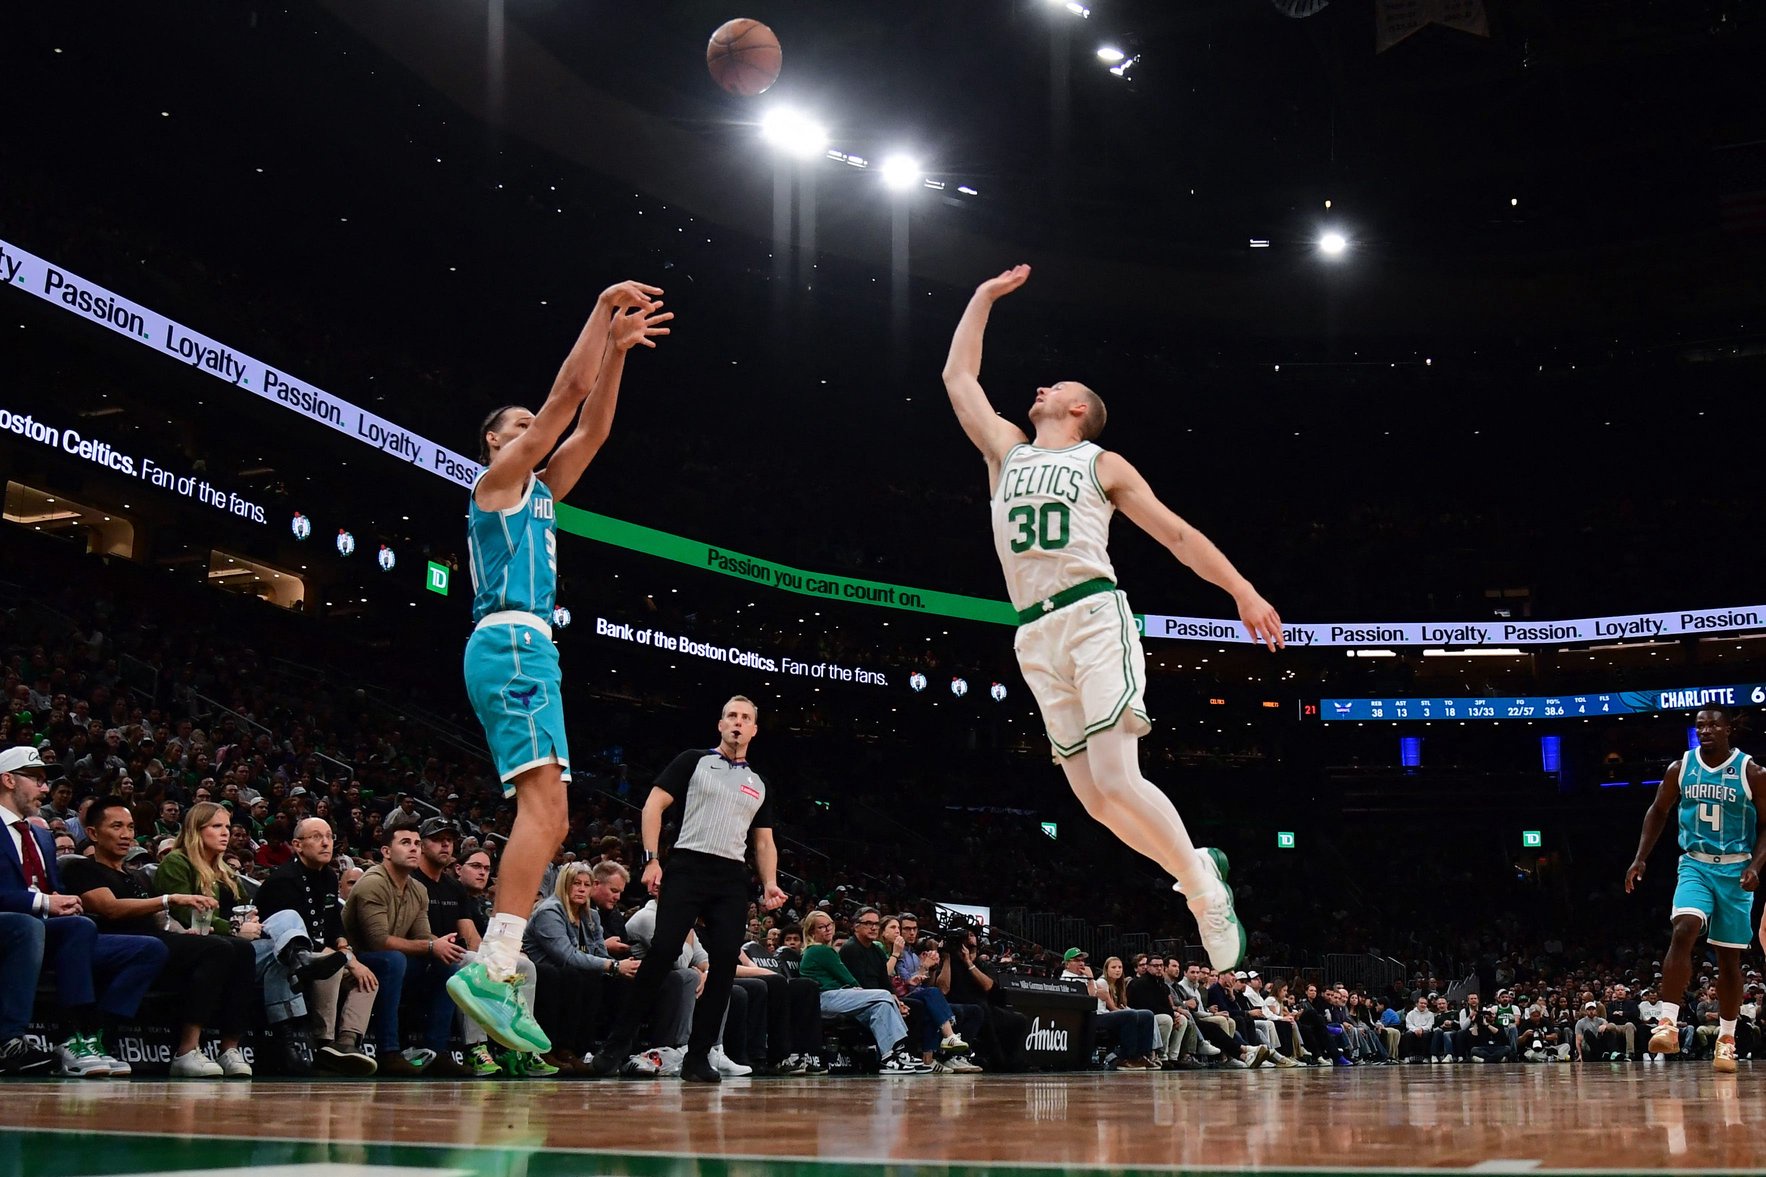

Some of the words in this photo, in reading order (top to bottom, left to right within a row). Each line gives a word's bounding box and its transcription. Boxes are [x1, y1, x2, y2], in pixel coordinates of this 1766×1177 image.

[44, 267, 149, 340] Passion.
[165, 324, 249, 386] Loyalty.
[263, 369, 345, 427] Passion.
[357, 413, 424, 464] Loyalty.
[434, 449, 478, 485] Passi
[62, 429, 138, 477] Celtics.
[141, 458, 175, 490] Fan
[178, 477, 196, 497] of
[199, 481, 226, 509] the
[229, 492, 268, 525] fans.
[1004, 464, 1083, 504] CELTICS
[1008, 502, 1071, 554] 30
[430, 567, 447, 589] TD
[707, 548, 771, 582] Passion
[774, 569, 803, 589] you
[805, 578, 840, 596] can
[843, 583, 896, 604] count
[899, 592, 926, 609] on.
[1165, 618, 1240, 639] Passion.
[1330, 626, 1410, 642] Passion.
[1421, 625, 1492, 644] Loyalty.
[1503, 624, 1583, 641] Passion.
[1594, 616, 1668, 638] Loyalty.
[1680, 610, 1764, 631] Passion.
[596, 617, 634, 642] Bank
[636, 629, 653, 646] of
[654, 631, 677, 650] the
[679, 636, 727, 662] Boston
[728, 648, 779, 673] Celtics.
[781, 658, 809, 676] Fan
[811, 662, 827, 678] of
[828, 664, 852, 681] the
[854, 667, 889, 686] fans.
[1304, 704, 1317, 715] 21
[1371, 708, 1384, 718] 38
[1397, 708, 1408, 717] 13
[1423, 708, 1430, 717] 3
[1445, 708, 1456, 717] 18
[1468, 707, 1495, 717] 13/33
[1508, 706, 1535, 717] 22/57
[1544, 706, 1565, 716] 38.6
[1578, 704, 1586, 714] 4
[1602, 703, 1609, 713] 4
[1660, 687, 1736, 710] CHARLOTTE
[1684, 783, 1737, 803] HORNETS
[1699, 803, 1720, 832] 4
[1279, 834, 1293, 845] TD
[1525, 833, 1540, 844] TD
[752, 957, 778, 968] PIMCO
[1025, 1016, 1068, 1052] Amica
[118, 1037, 171, 1063] tBlue
